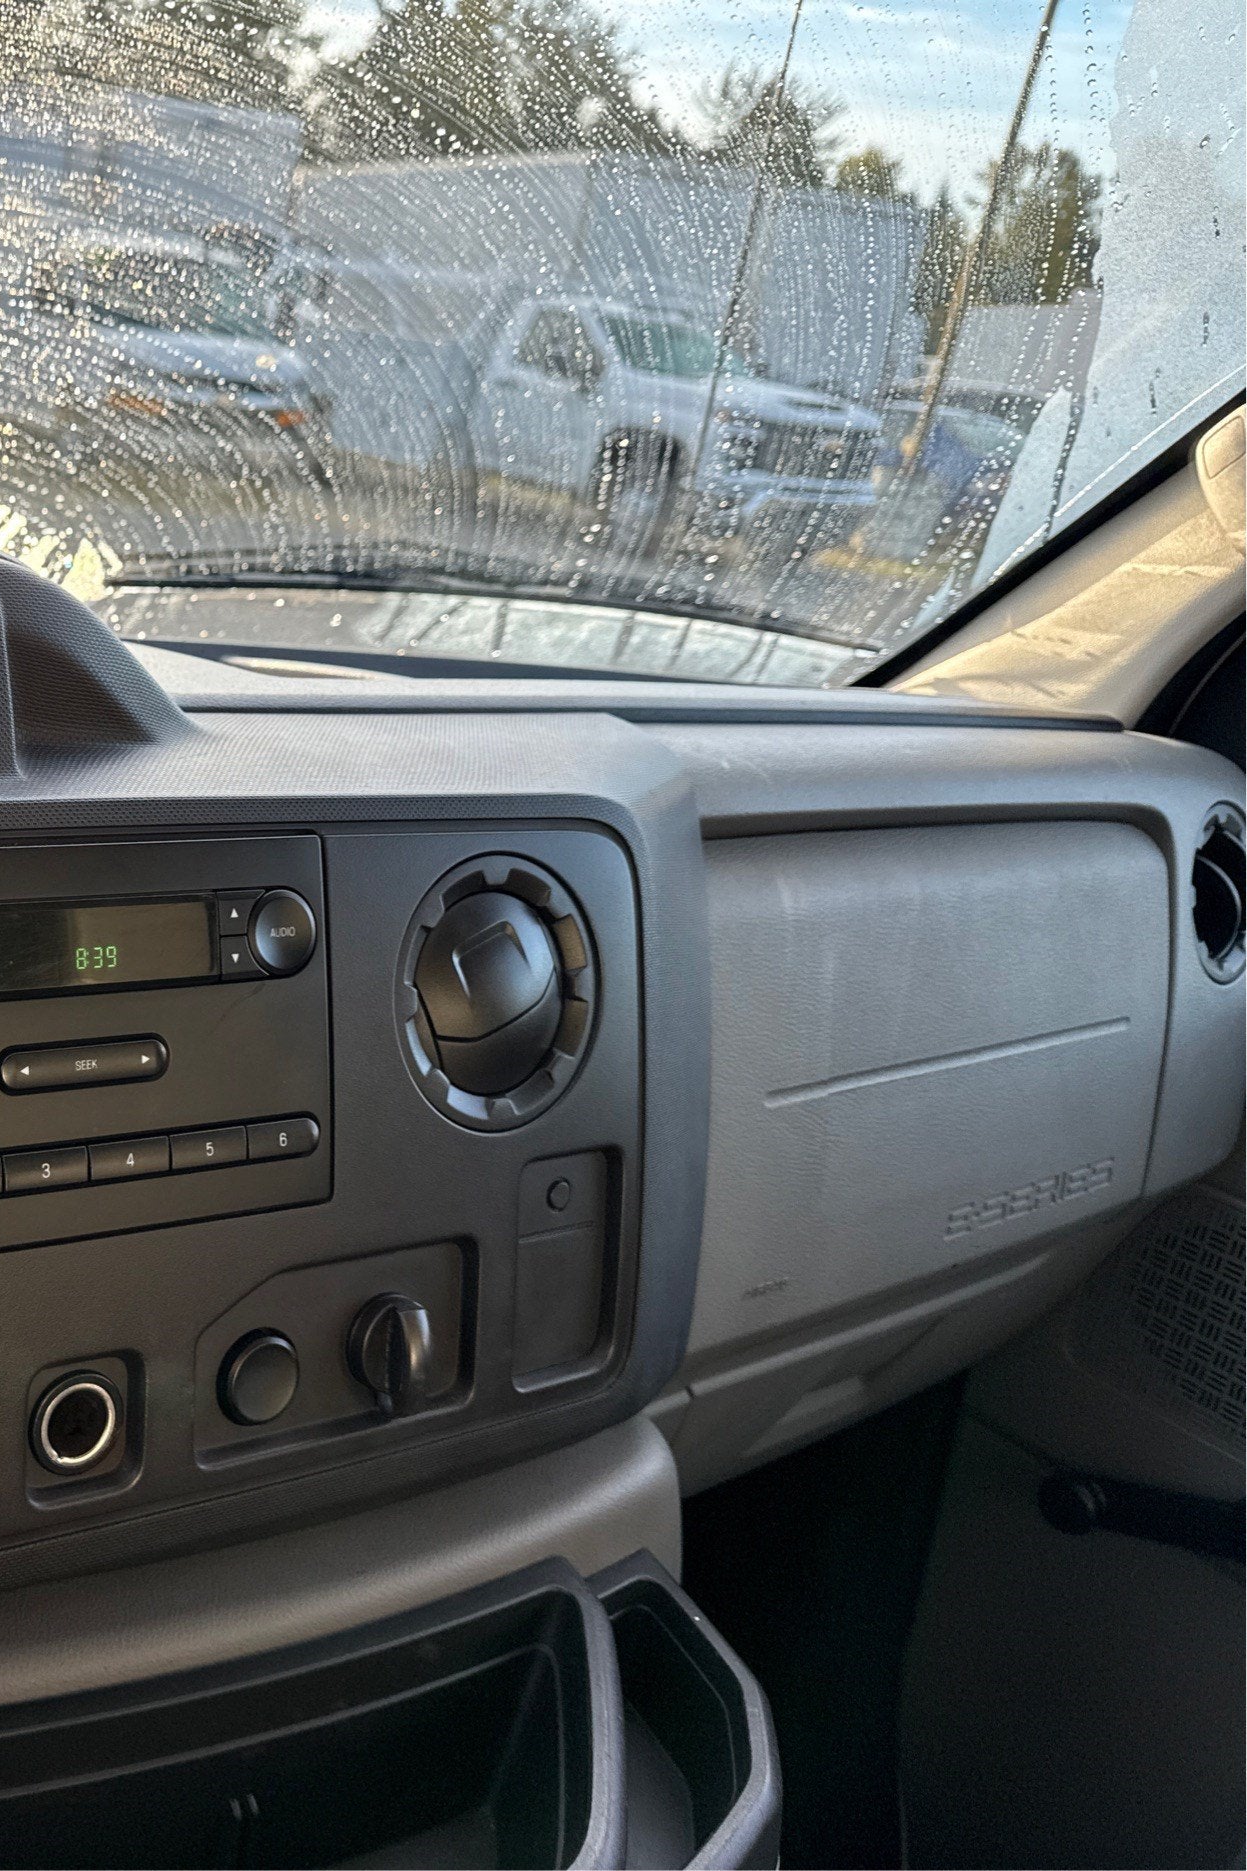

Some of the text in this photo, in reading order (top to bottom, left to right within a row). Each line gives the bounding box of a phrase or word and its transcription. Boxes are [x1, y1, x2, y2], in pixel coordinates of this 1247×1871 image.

[270, 926, 296, 938] AUDIO
[76, 946, 117, 970] 8:39
[75, 1059, 98, 1071] SEEK
[42, 1163, 51, 1179] 3
[126, 1152, 135, 1168] 4
[206, 1141, 214, 1157] 5
[279, 1132, 288, 1148] 6
